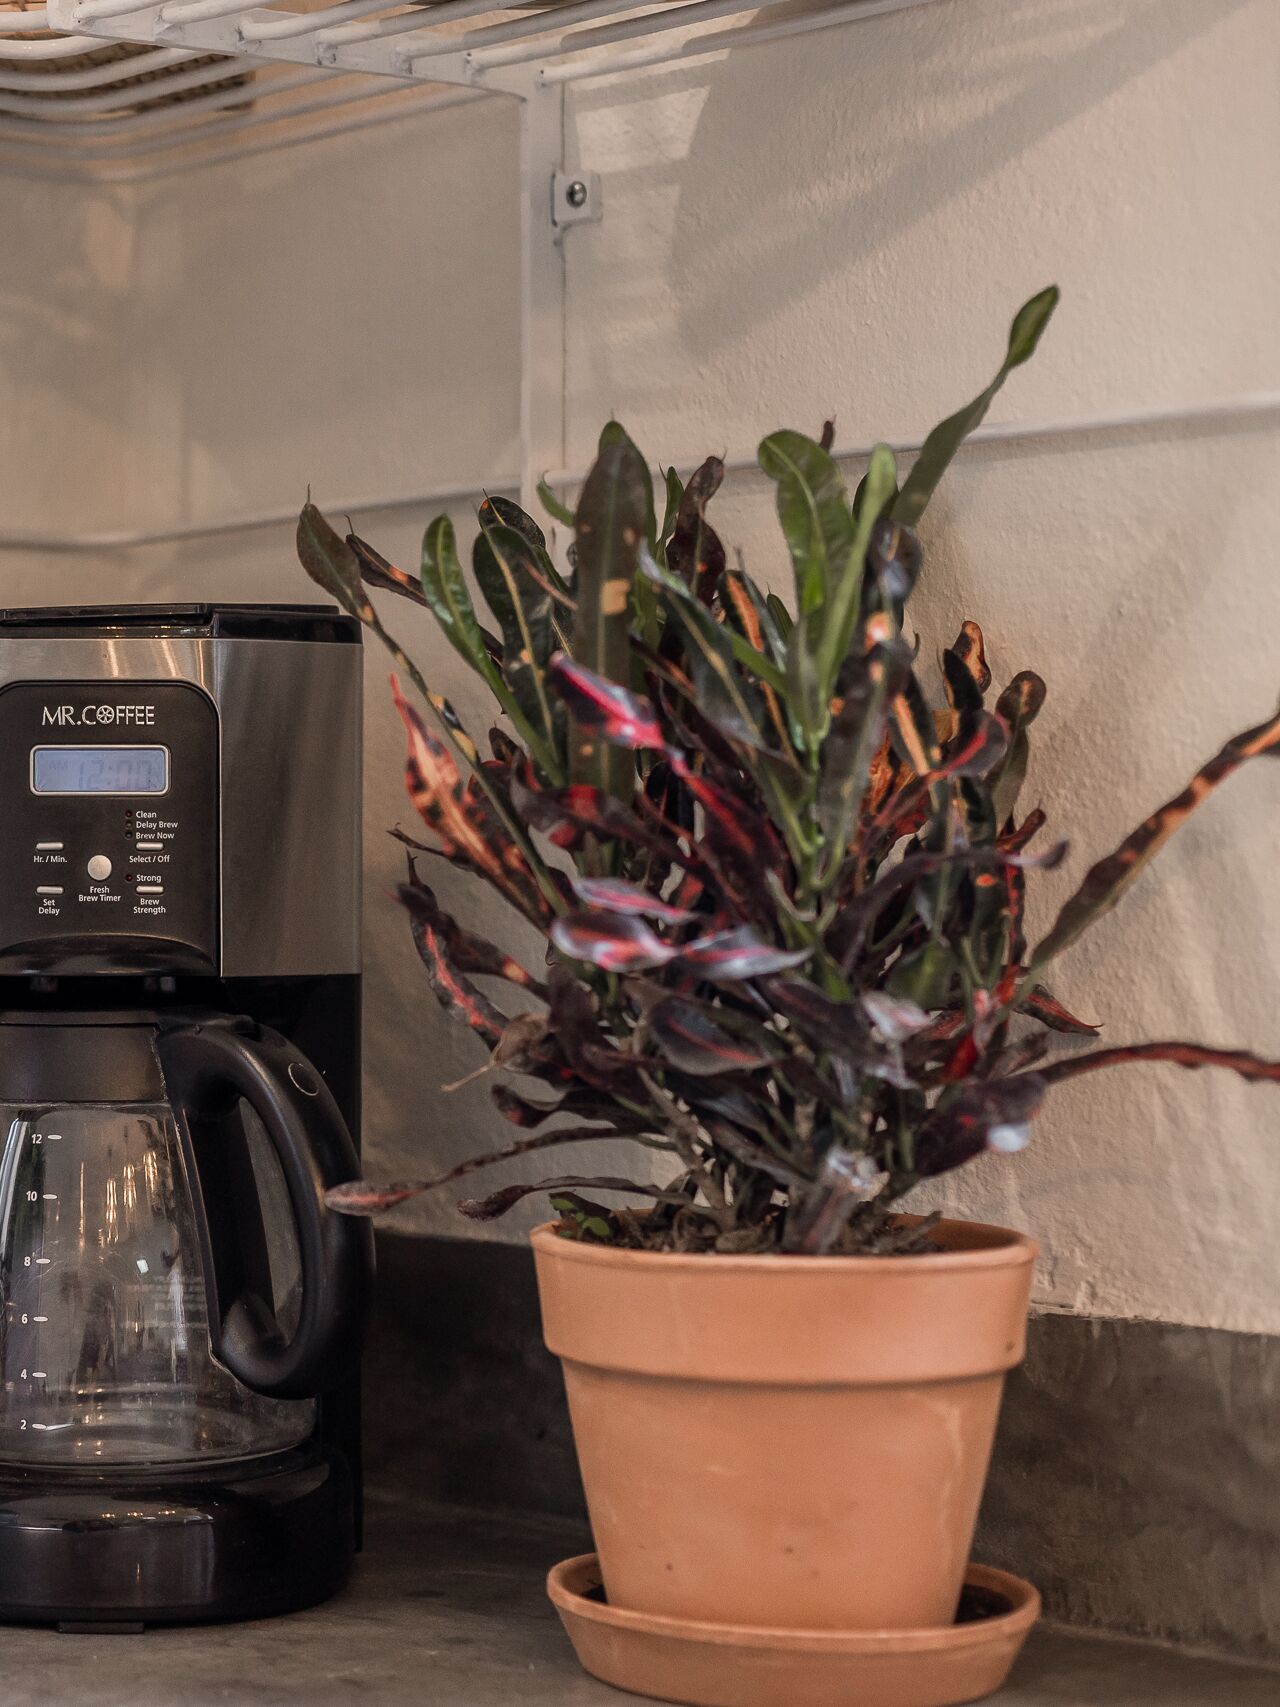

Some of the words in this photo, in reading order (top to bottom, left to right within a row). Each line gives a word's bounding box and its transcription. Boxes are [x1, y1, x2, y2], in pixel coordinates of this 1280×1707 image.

[135, 810, 157, 819] Clean
[135, 820, 157, 830] Delay
[158, 820, 179, 829] Brew
[135, 831, 155, 839] Brew
[156, 831, 175, 839] Now
[128, 855, 152, 863] Select
[157, 855, 171, 863] Off
[136, 874, 162, 883] Strong
[89, 885, 110, 894] Fresh
[43, 898, 56, 906] Set
[78, 894, 98, 902] Brew
[99, 894, 122, 902] Timer
[140, 898, 160, 906] Brew
[38, 906, 61, 916] Delay
[133, 905, 167, 916] Strength
[31, 1133, 43, 1144] 12
[26, 1190, 38, 1202] 10
[23, 1256, 31, 1267] 8
[21, 1313, 28, 1324] 6
[20, 1369, 28, 1380] 4
[20, 1419, 27, 1430] 2
